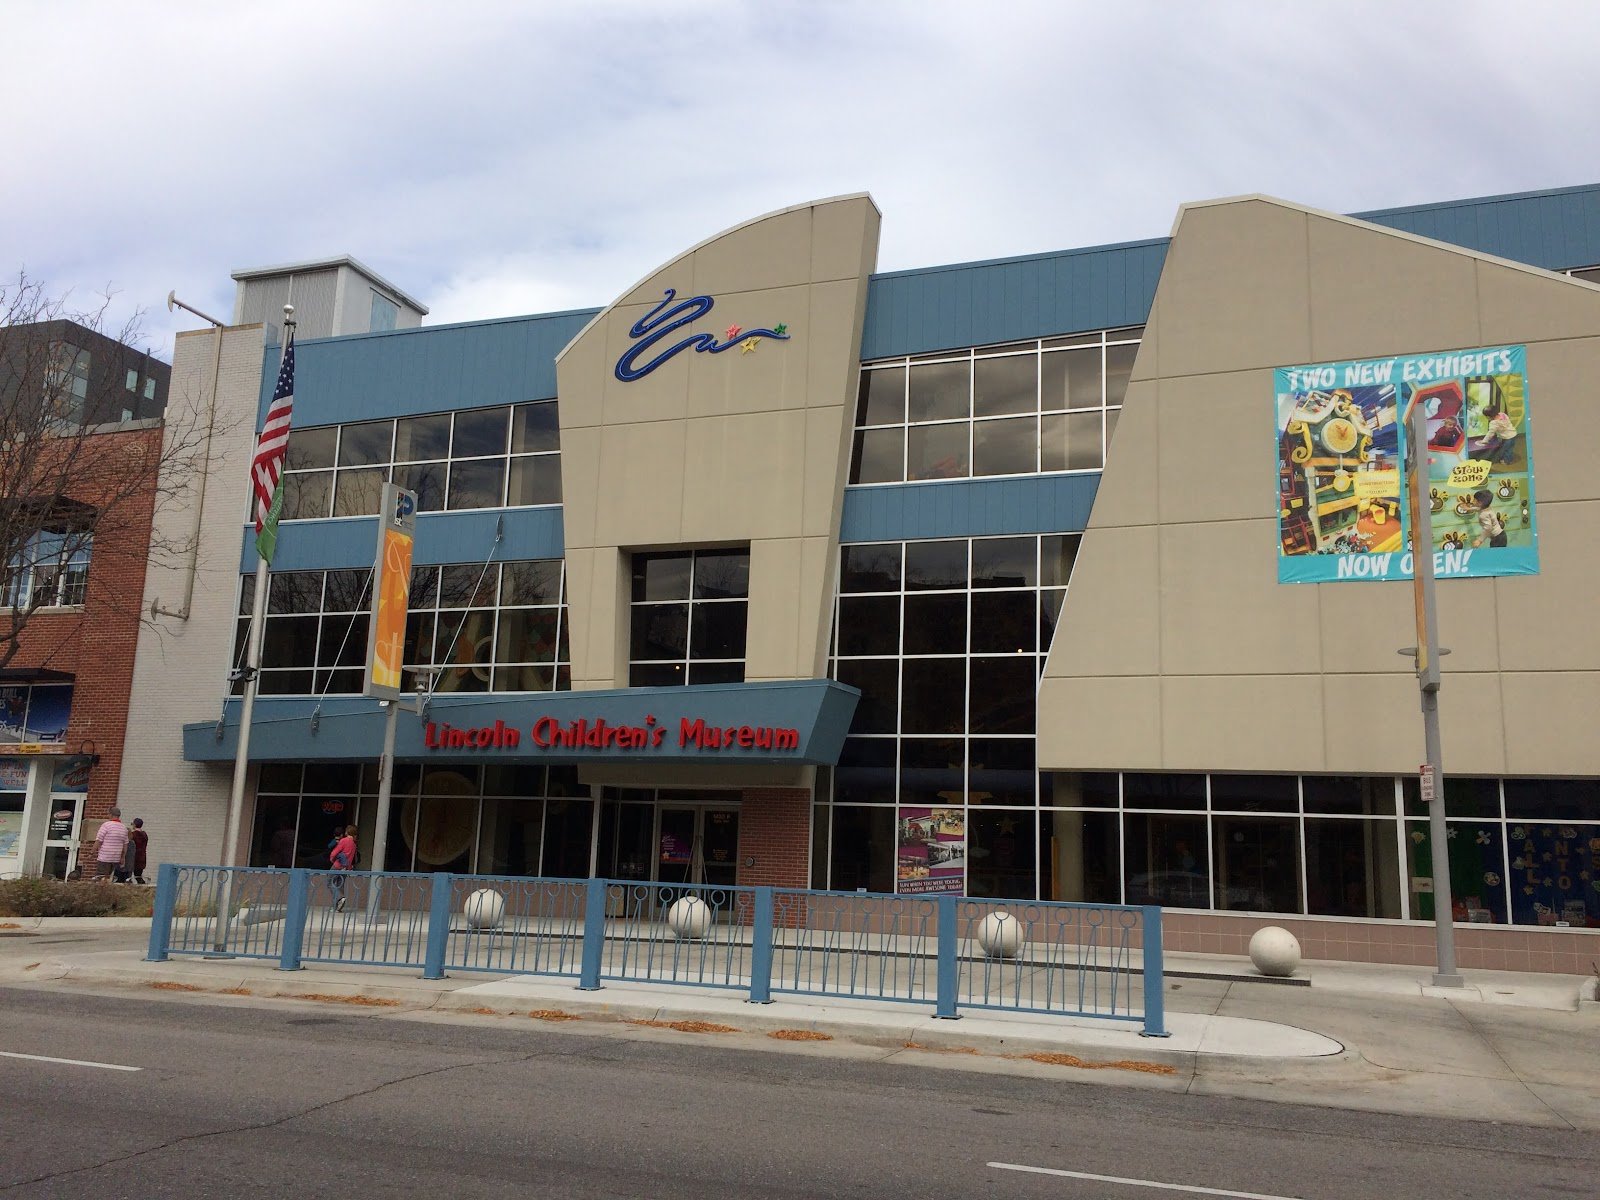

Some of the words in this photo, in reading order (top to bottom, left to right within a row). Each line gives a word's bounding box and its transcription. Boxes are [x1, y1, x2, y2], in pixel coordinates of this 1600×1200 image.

[1288, 367, 1336, 391] TWO
[1345, 360, 1394, 386] NEW
[1402, 350, 1512, 382] EXHIBITS
[1338, 552, 1392, 578] NOW
[1400, 549, 1473, 574] OEN!
[424, 720, 520, 750] Lincoln
[531, 714, 667, 751] Children's
[678, 717, 799, 750] Museum
